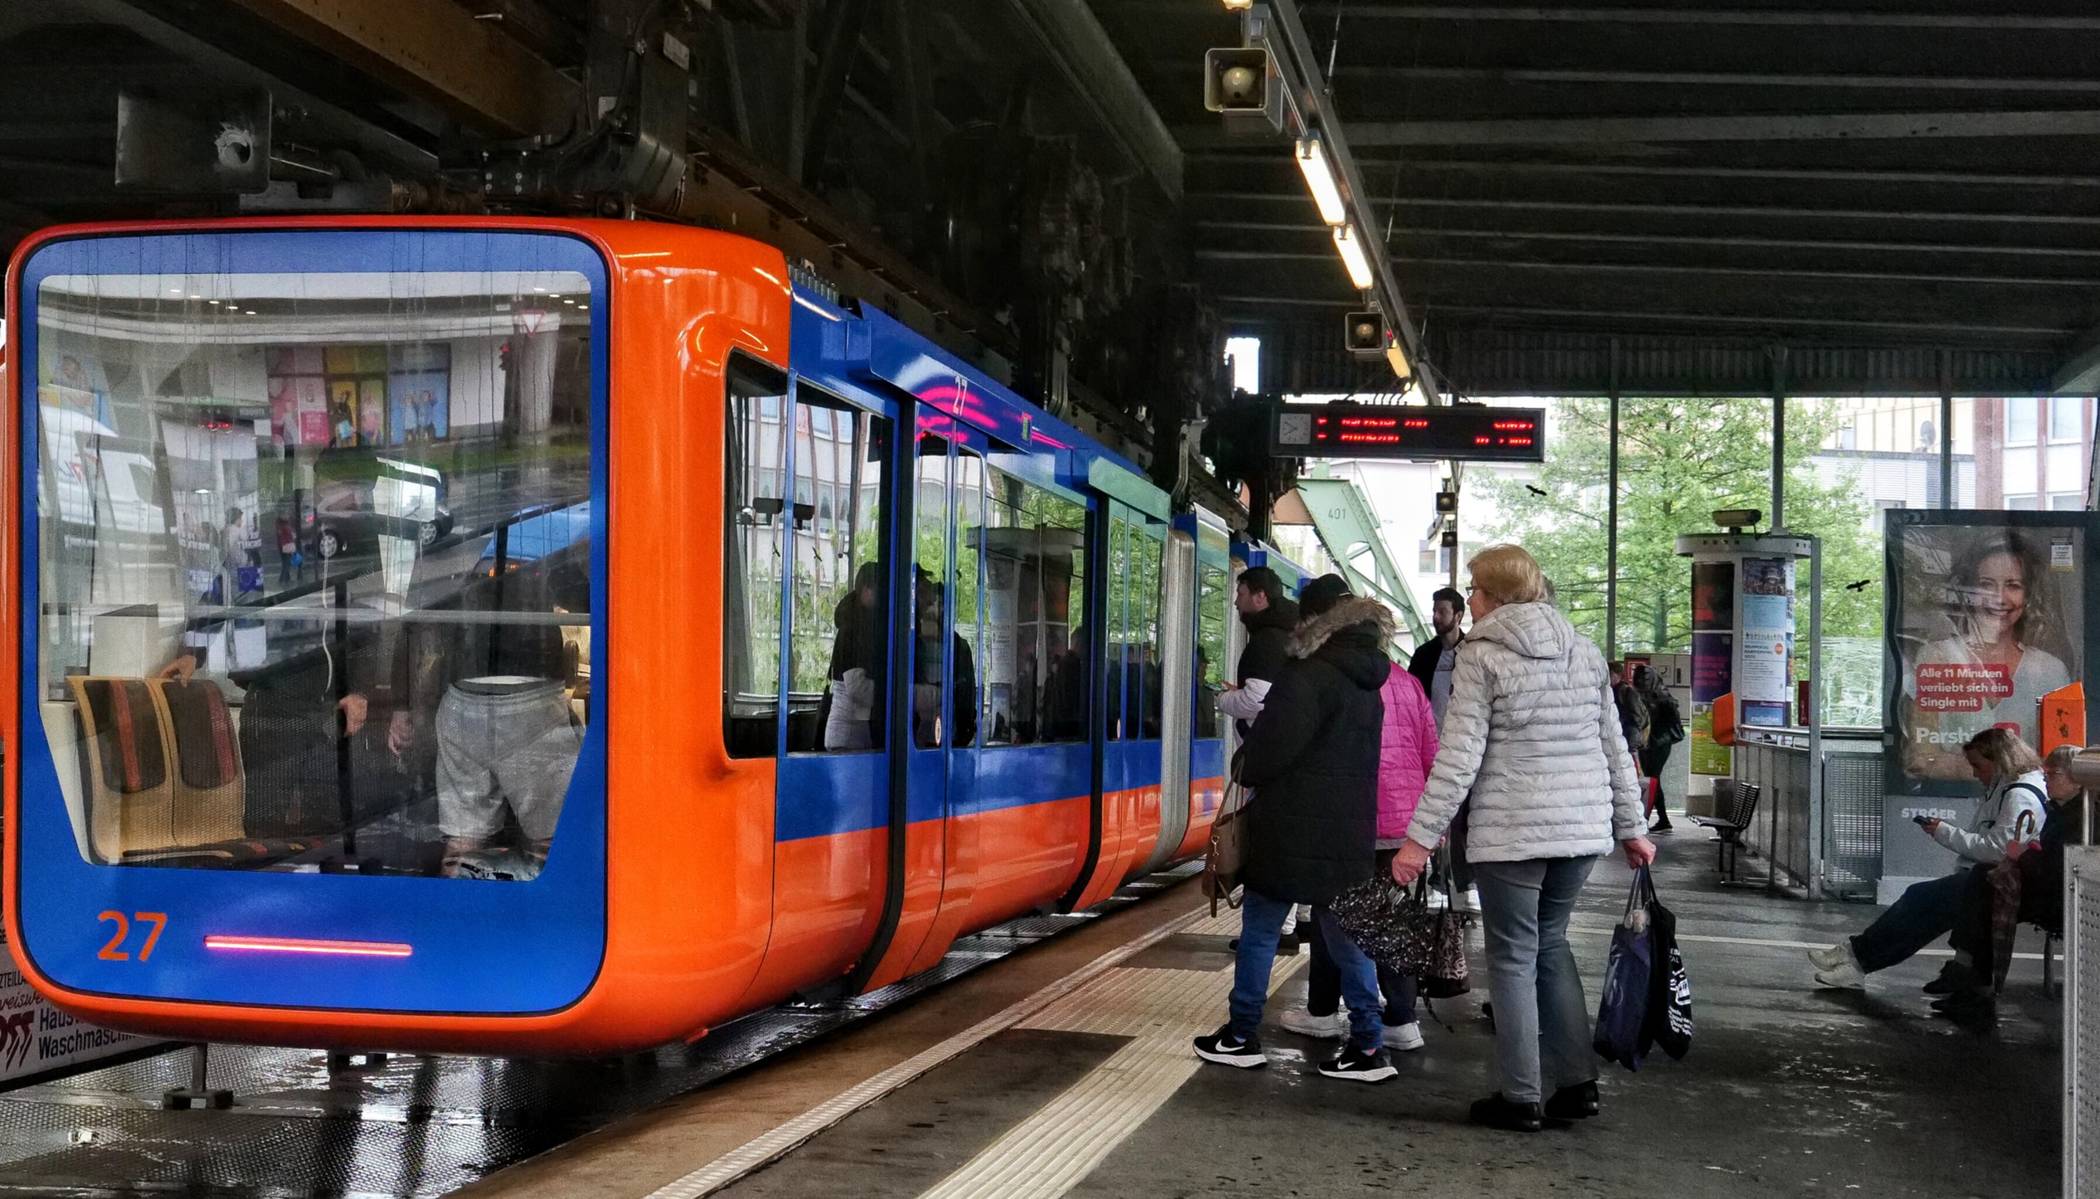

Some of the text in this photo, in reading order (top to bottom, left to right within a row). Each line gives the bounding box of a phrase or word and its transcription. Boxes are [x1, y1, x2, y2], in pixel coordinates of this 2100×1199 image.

[953, 375, 968, 417] 27
[1328, 508, 1346, 520] 401
[1919, 668, 2003, 678] Alle 11 Minuten
[1920, 682, 2008, 693] verliebt sich ein
[1920, 697, 1978, 709] Single mit
[1915, 726, 1976, 744] Parshi
[96, 910, 168, 962] 27
